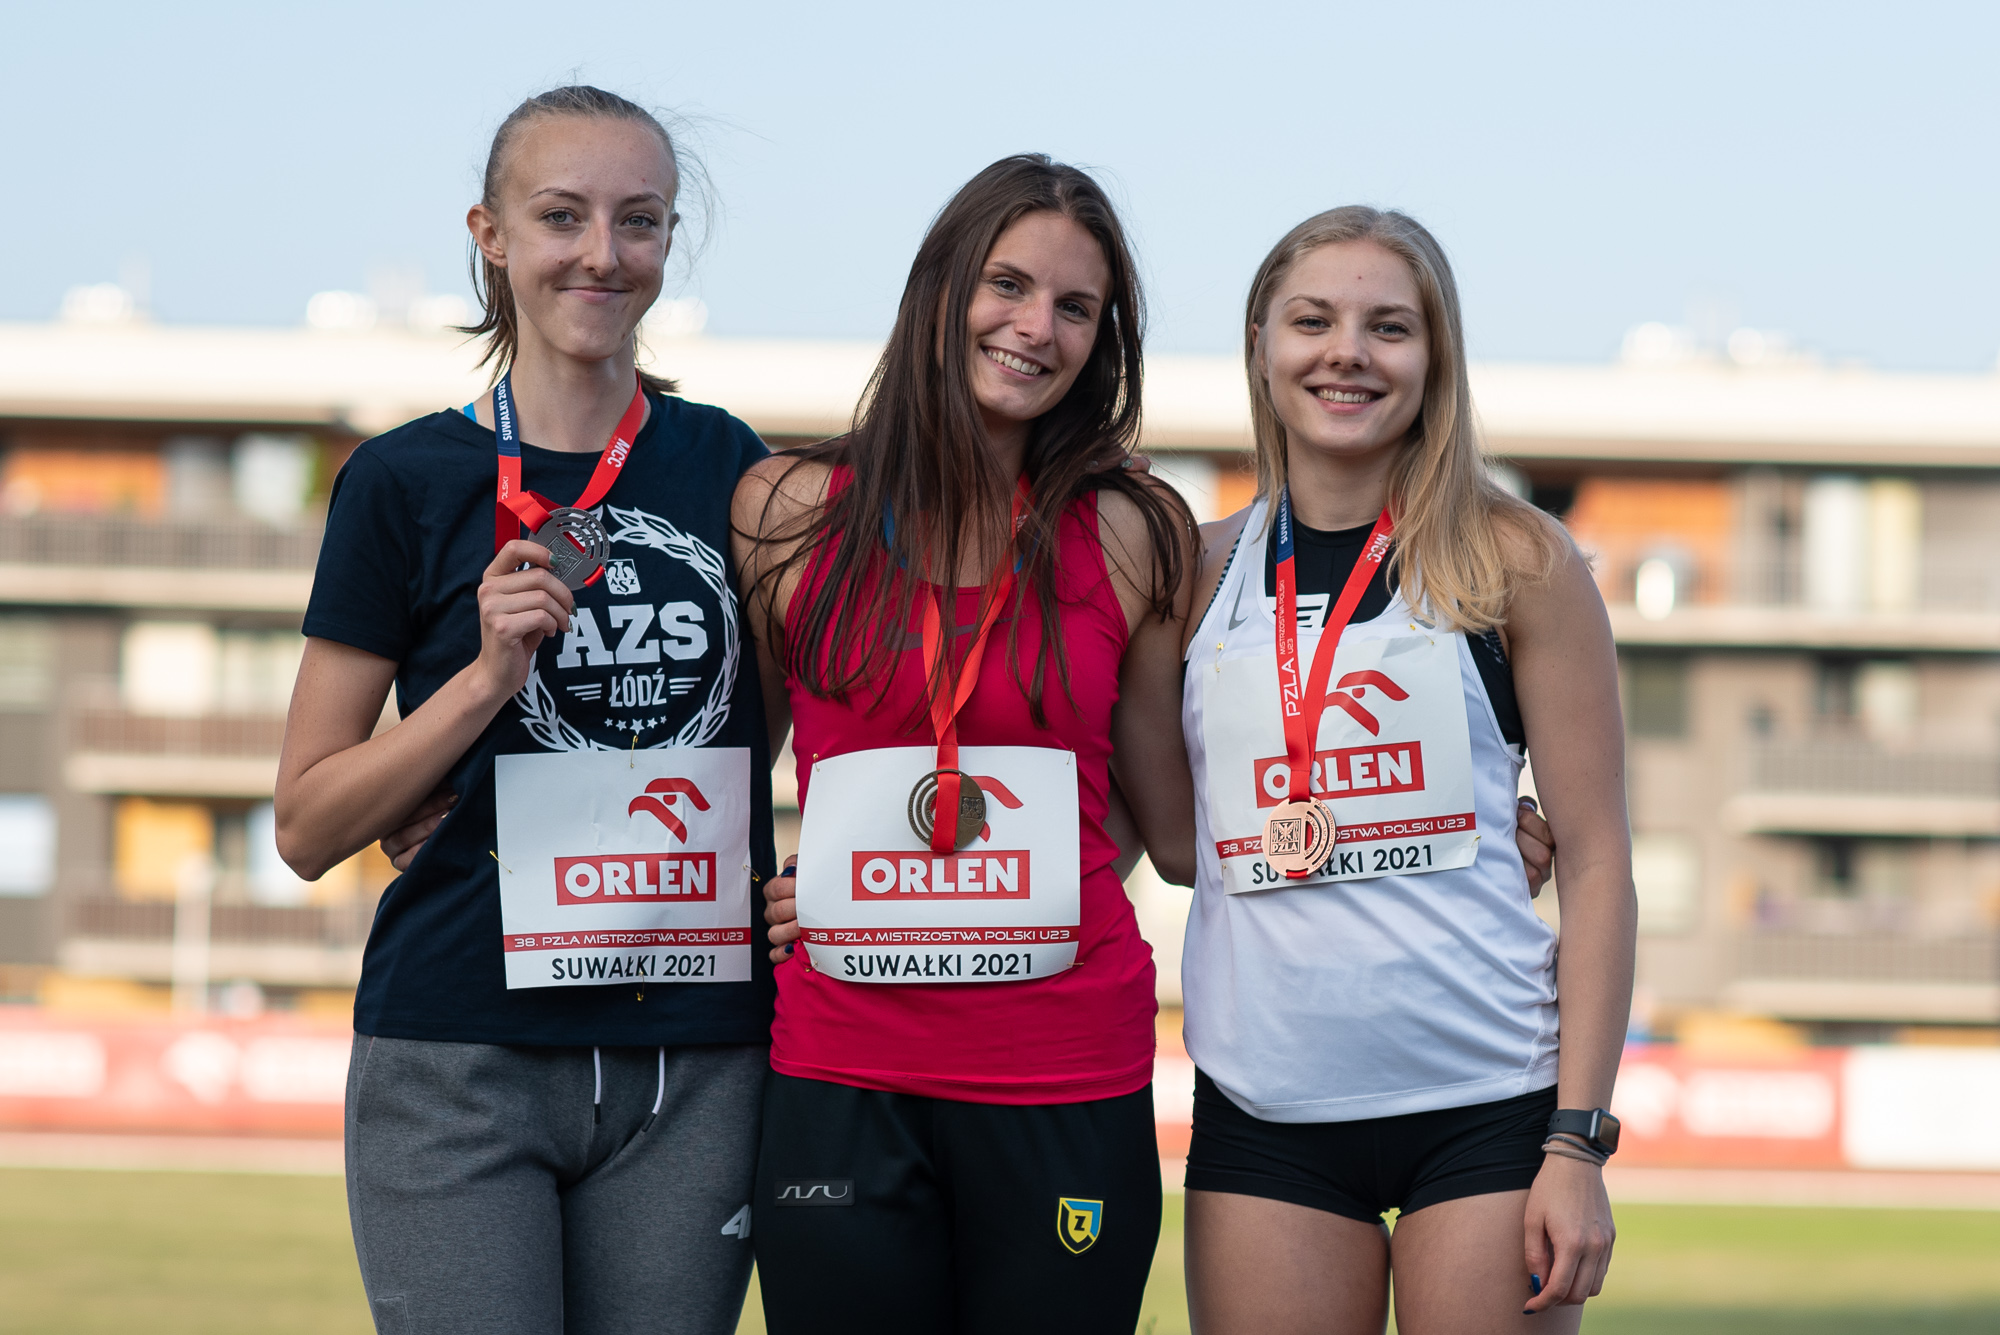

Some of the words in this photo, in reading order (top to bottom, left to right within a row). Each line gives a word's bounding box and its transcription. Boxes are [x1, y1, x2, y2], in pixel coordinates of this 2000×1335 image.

[499, 400, 512, 441] SUWAŁKI
[607, 437, 630, 467] MCC
[1367, 533, 1391, 563] MCC
[556, 601, 708, 668] AZS
[609, 668, 667, 707] ŁÓDŹ
[1281, 657, 1300, 717] PZLA
[1263, 749, 1413, 799] ORLEN
[1383, 822, 1433, 835] POLSKI
[1437, 817, 1467, 830] U23
[1222, 843, 1241, 854] 38.
[1244, 841, 1262, 850] PZ
[1272, 842, 1298, 853] PZLA
[564, 860, 708, 898] ORLEN
[860, 857, 1019, 894] ORLEN
[1252, 851, 1364, 884] SUŁKI
[1373, 844, 1433, 872] 2021
[514, 937, 538, 948] 38.
[542, 935, 580, 946] PZLA
[583, 933, 675, 945] MISTRZOSTWA
[678, 932, 719, 942] POLSKI
[721, 931, 744, 941] U23
[808, 931, 831, 942] 38.
[834, 932, 873, 942] PZLA
[875, 931, 982, 942] MISTRZOSTWA
[984, 930, 1036, 941] POLSKI
[1039, 930, 1070, 940] U23
[551, 954, 656, 980] SUWAŁKI
[663, 954, 715, 977] 2021
[843, 954, 961, 977] SUWAŁKI
[971, 953, 1032, 976] 2021
[1073, 1215, 1087, 1232] Z
